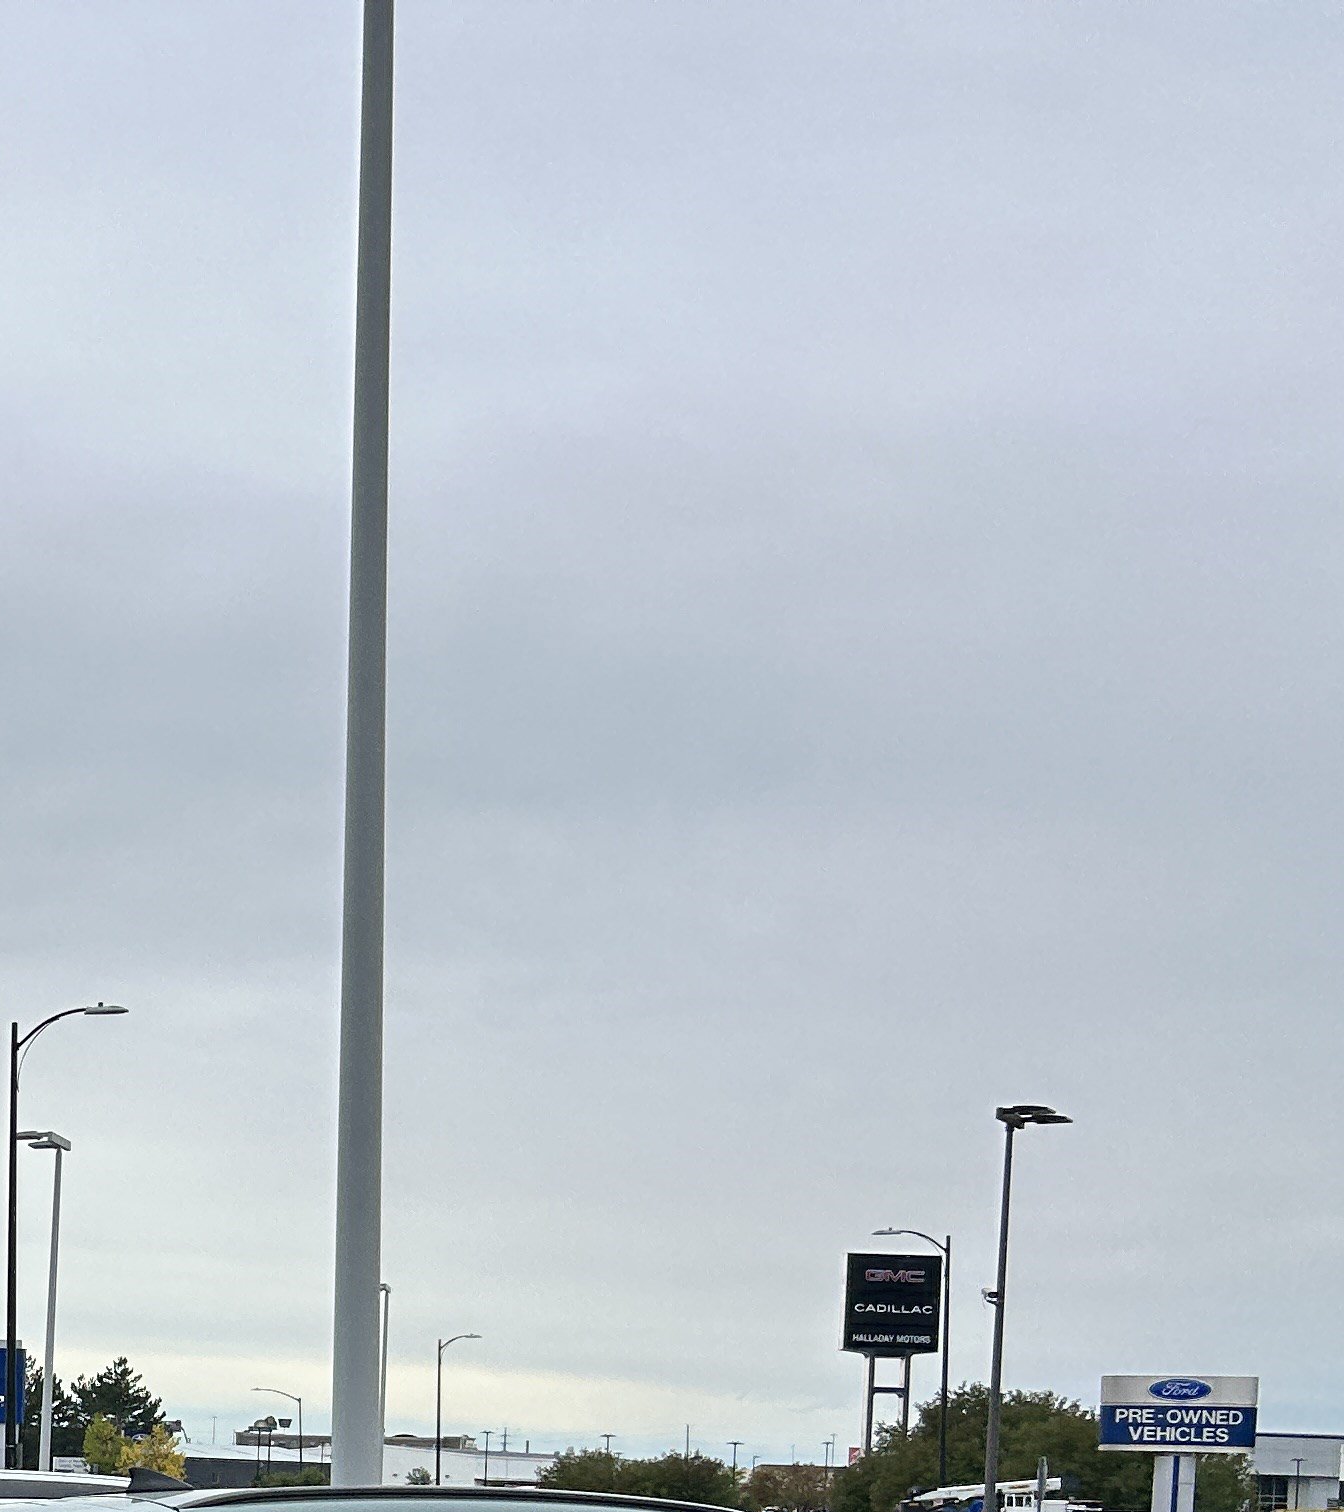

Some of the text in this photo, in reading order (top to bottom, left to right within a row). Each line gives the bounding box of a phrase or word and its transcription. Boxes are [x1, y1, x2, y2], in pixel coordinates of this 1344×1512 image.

[865, 1269, 926, 1283] GMC
[854, 1303, 933, 1314] CADILLAC
[852, 1333, 931, 1344] HALLADAY MOTORS
[1162, 1381, 1199, 1397] Ford
[1128, 1426, 1229, 1443] VEHICLES
